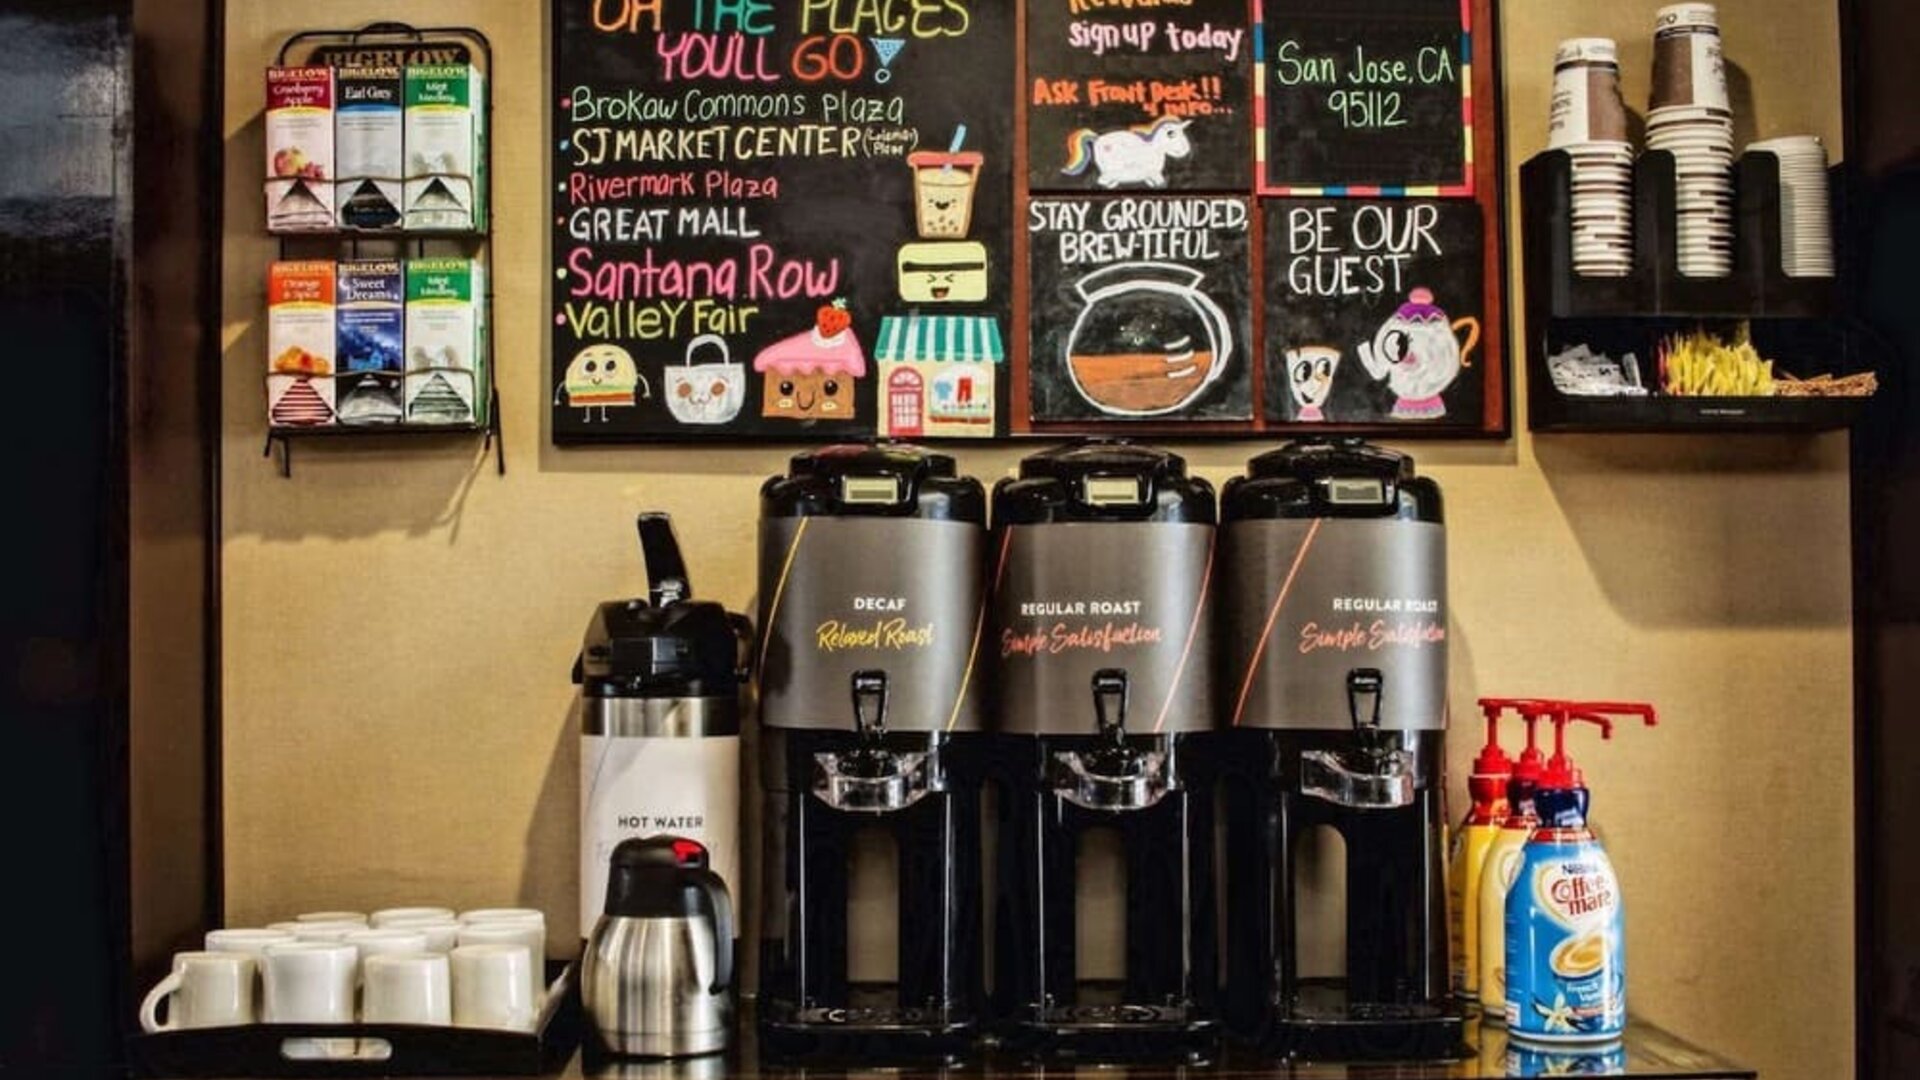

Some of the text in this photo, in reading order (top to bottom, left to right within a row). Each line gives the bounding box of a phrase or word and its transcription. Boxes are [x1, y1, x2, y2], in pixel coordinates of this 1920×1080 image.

[593, 0, 970, 38] OH THE PLACES
[1068, 20, 1244, 62] sign up today
[1278, 40, 1337, 85] San
[1417, 46, 1456, 83] CA
[345, 85, 392, 101] Earl Grey
[684, 89, 806, 123] Commons
[1327, 91, 1408, 129] 95112
[572, 127, 612, 166] SJ
[614, 125, 732, 162] MARKET
[734, 124, 862, 160] CENTER
[704, 170, 779, 199] Plaza
[568, 206, 761, 241] GREAT MALL
[1029, 200, 1091, 232] STAY
[1288, 204, 1442, 256] BE OUR
[352, 277, 385, 290] Sweet
[568, 243, 840, 300] Santana Row
[1288, 252, 1412, 296] GUEST
[346, 288, 392, 301] Dreams
[693, 301, 759, 336] Fair
[853, 597, 908, 611] DECAF
[1021, 600, 1141, 616] REGULAR ROAST
[1332, 598, 1402, 612] REGULAR
[882, 617, 936, 651] Roast
[1048, 621, 1162, 653] Satisfaction
[1299, 621, 1367, 654] Simple
[618, 816, 704, 828] HOT WATER
